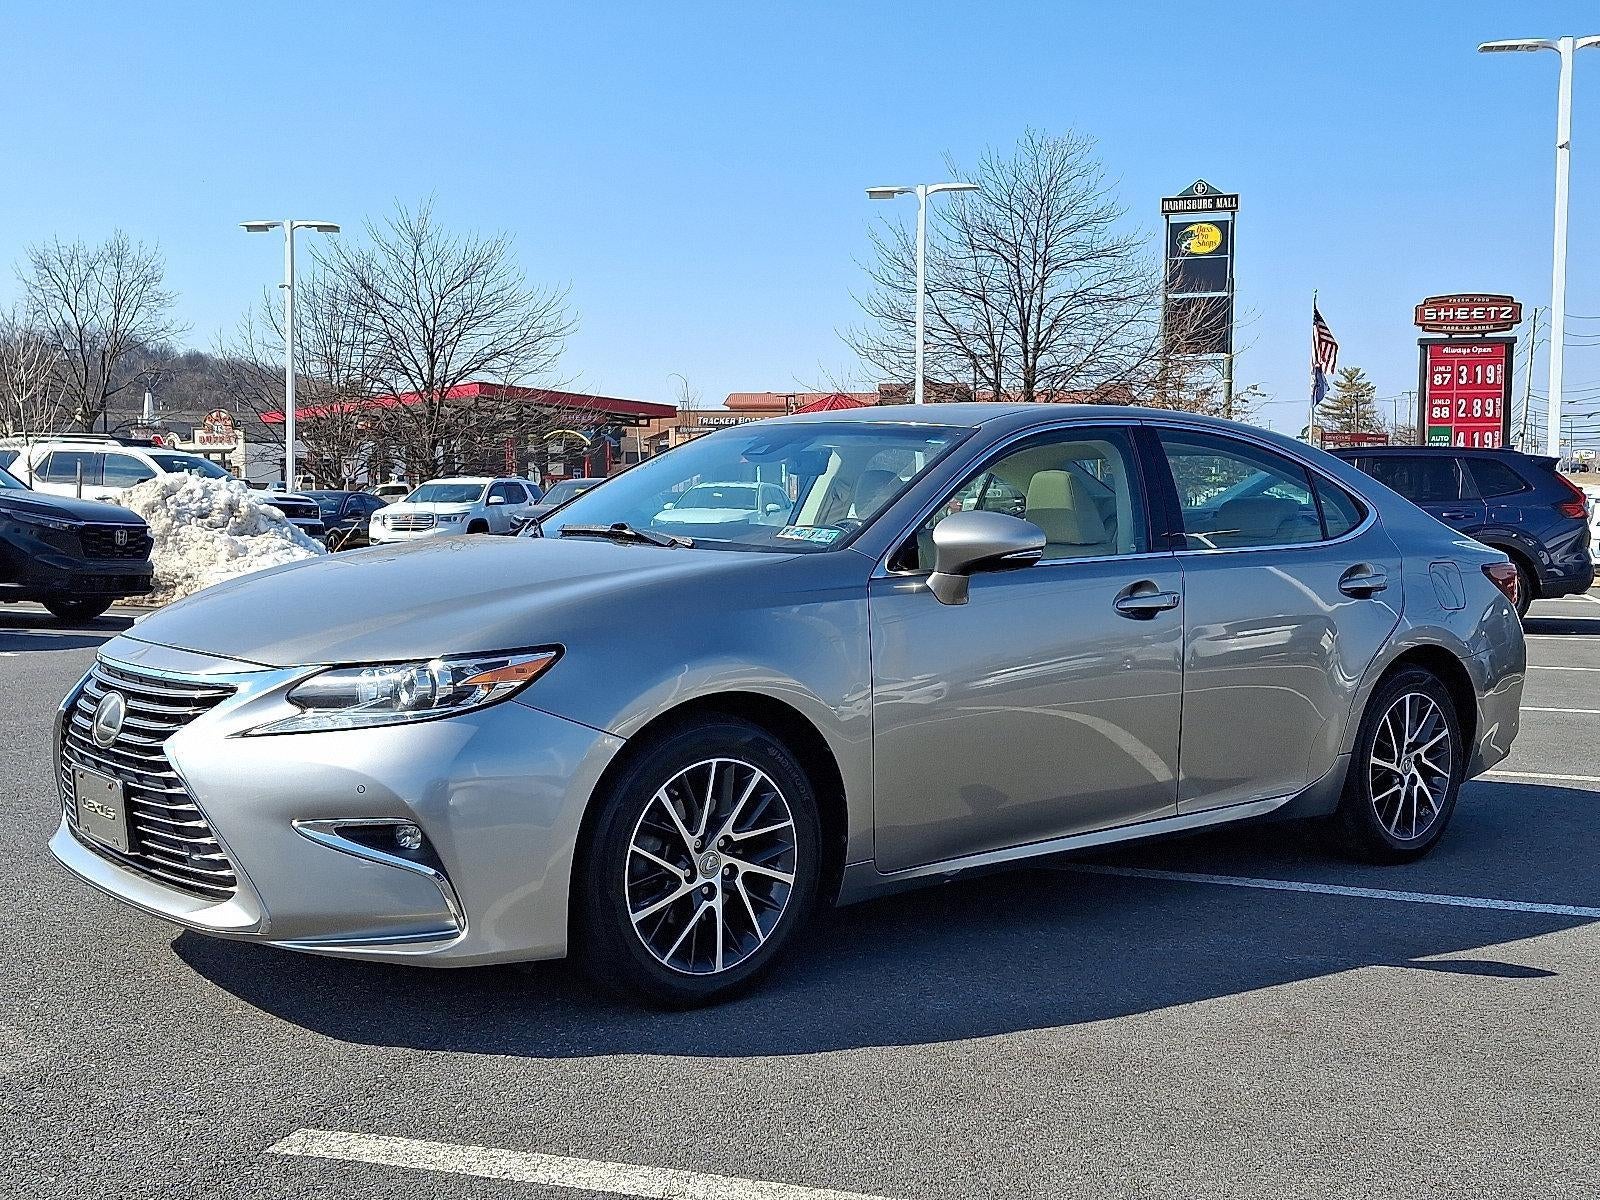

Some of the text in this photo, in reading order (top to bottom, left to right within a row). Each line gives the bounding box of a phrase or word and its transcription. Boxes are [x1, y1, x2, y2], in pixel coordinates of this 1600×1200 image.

[1163, 197, 1237, 211] HARRISBURG MALL
[1196, 225, 1213, 233] Bass
[1196, 240, 1217, 249] Shops
[1424, 307, 1513, 320] SHEETZ
[1442, 345, 1493, 355] Always Open
[1433, 373, 1452, 386] 87
[1458, 365, 1495, 385] 3.19
[1431, 406, 1450, 419] 88
[1457, 398, 1494, 418] 2.89
[697, 416, 736, 425] TRACKER
[1456, 431, 1493, 448] 419
[81, 796, 116, 821] LEXUS
